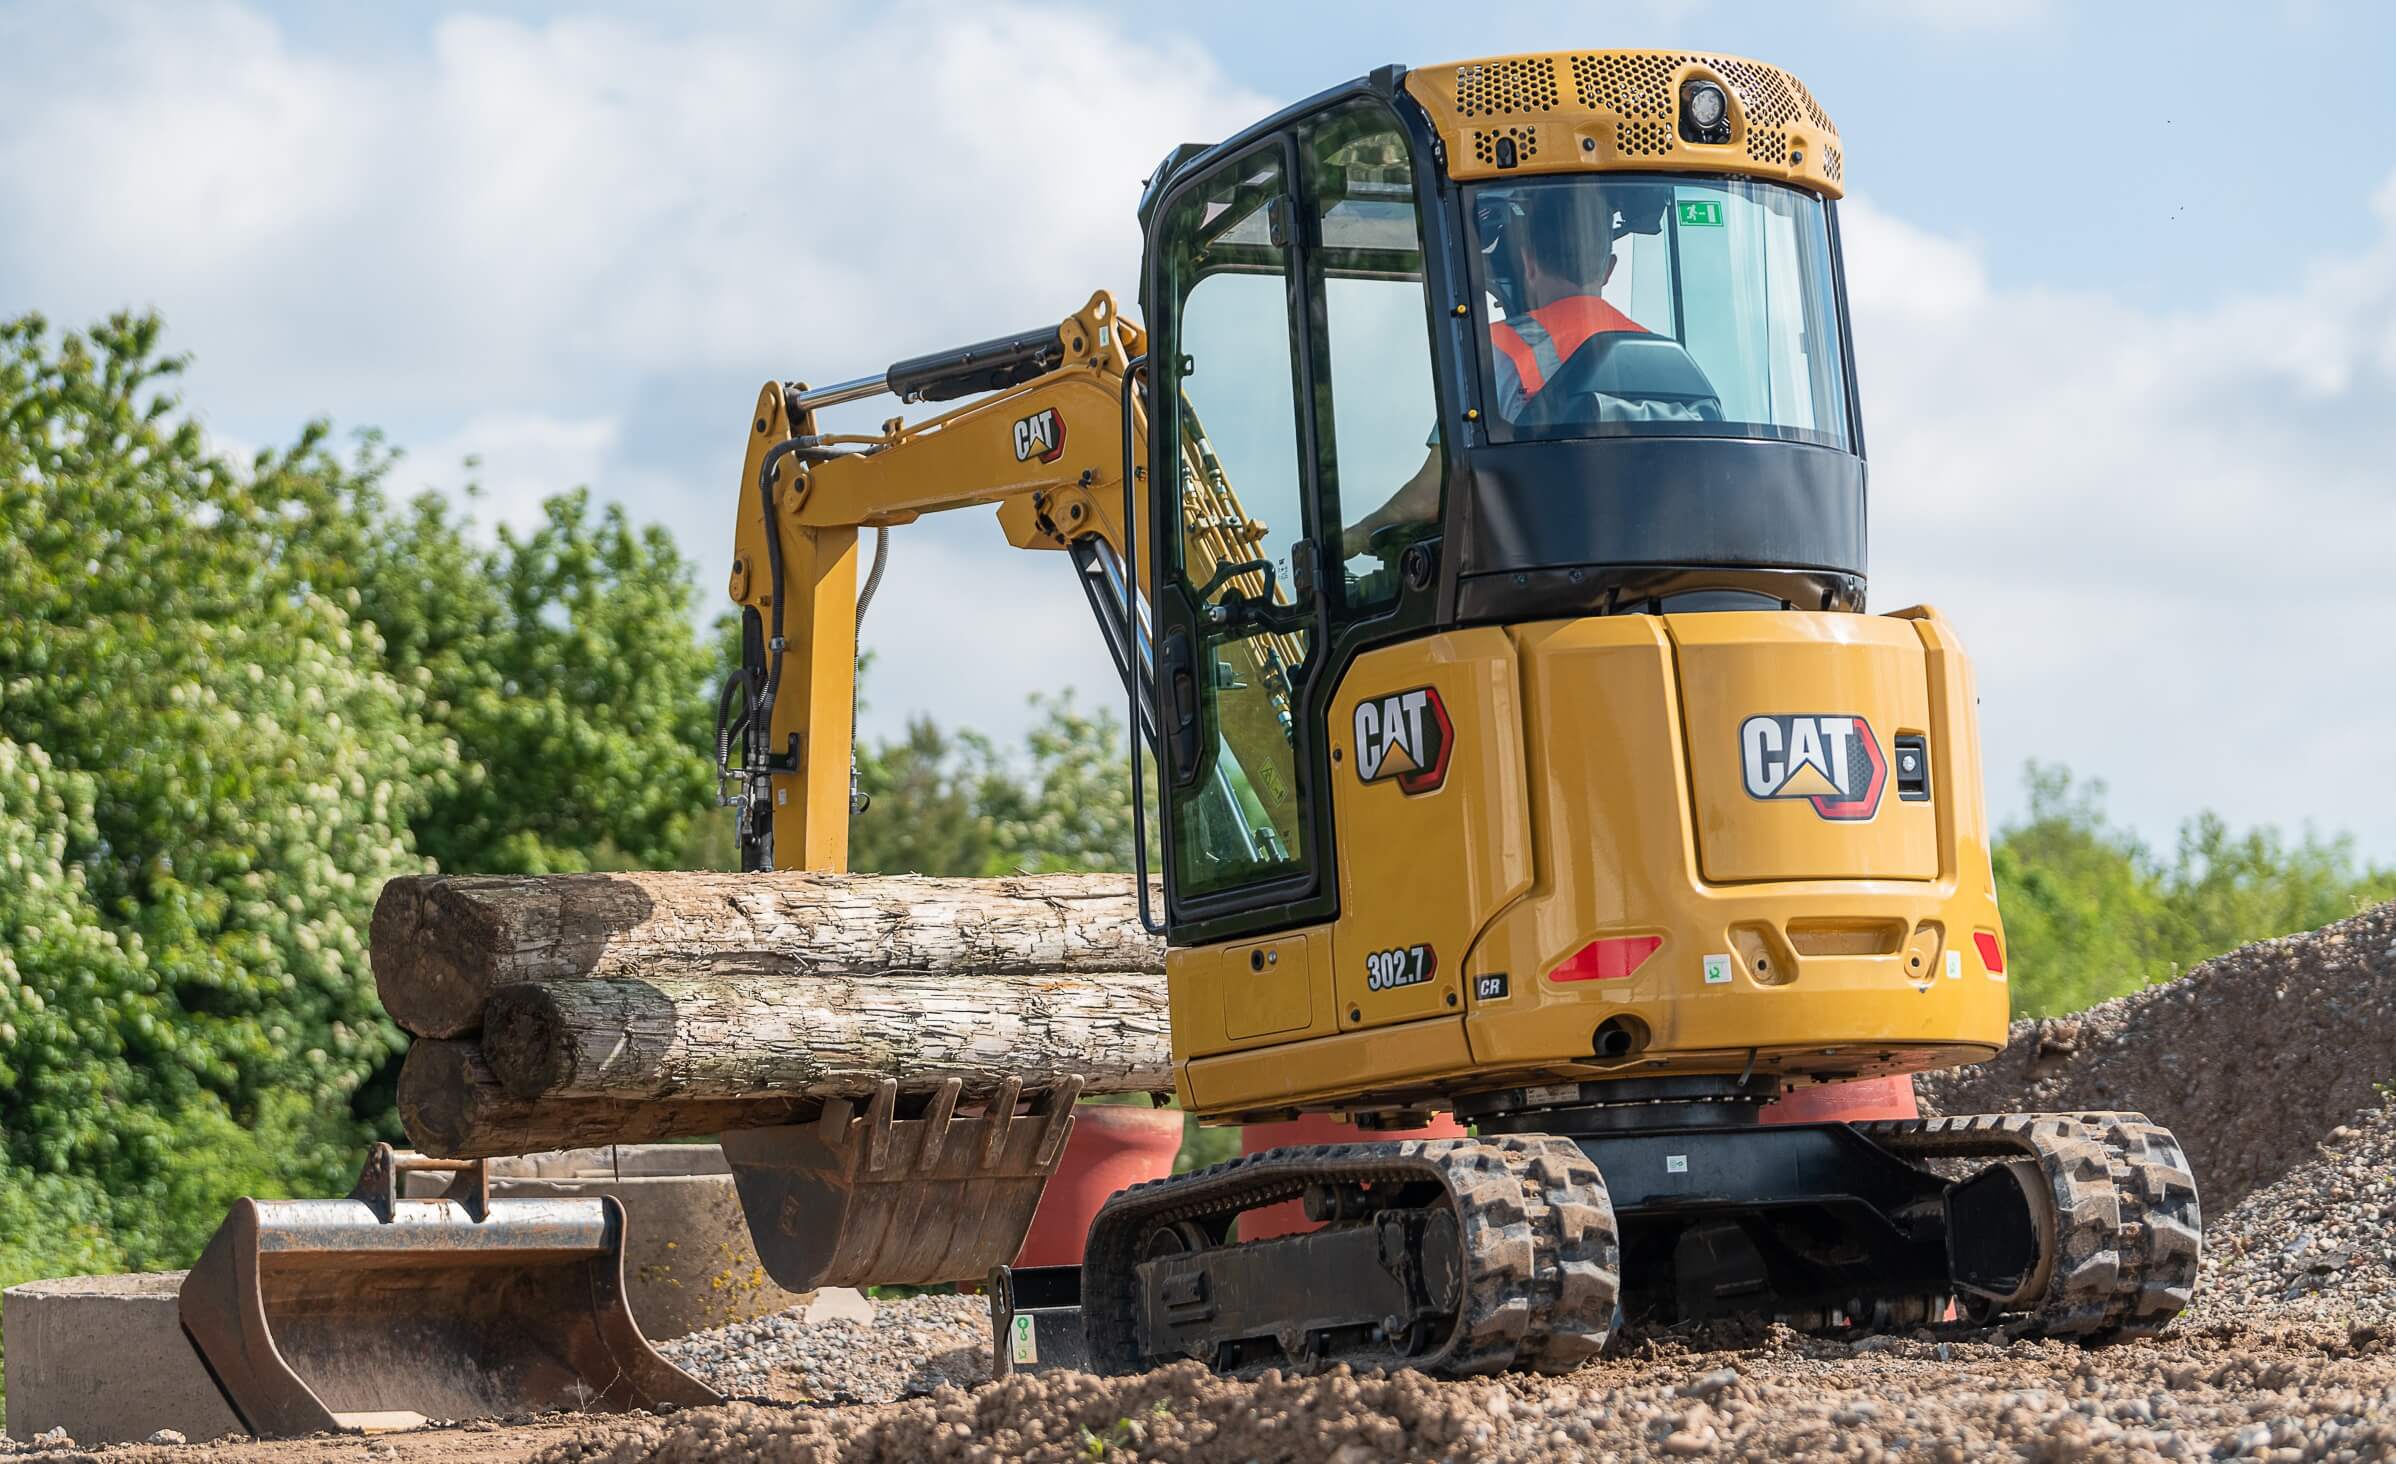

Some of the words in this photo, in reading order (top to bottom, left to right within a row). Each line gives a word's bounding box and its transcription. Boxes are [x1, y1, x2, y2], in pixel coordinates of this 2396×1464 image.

[1014, 409, 1053, 461] CAT
[1355, 690, 1427, 780] CAT
[1743, 717, 1854, 796] CAT
[1367, 947, 1425, 990] 302.7
[1480, 978, 1501, 996] CR
